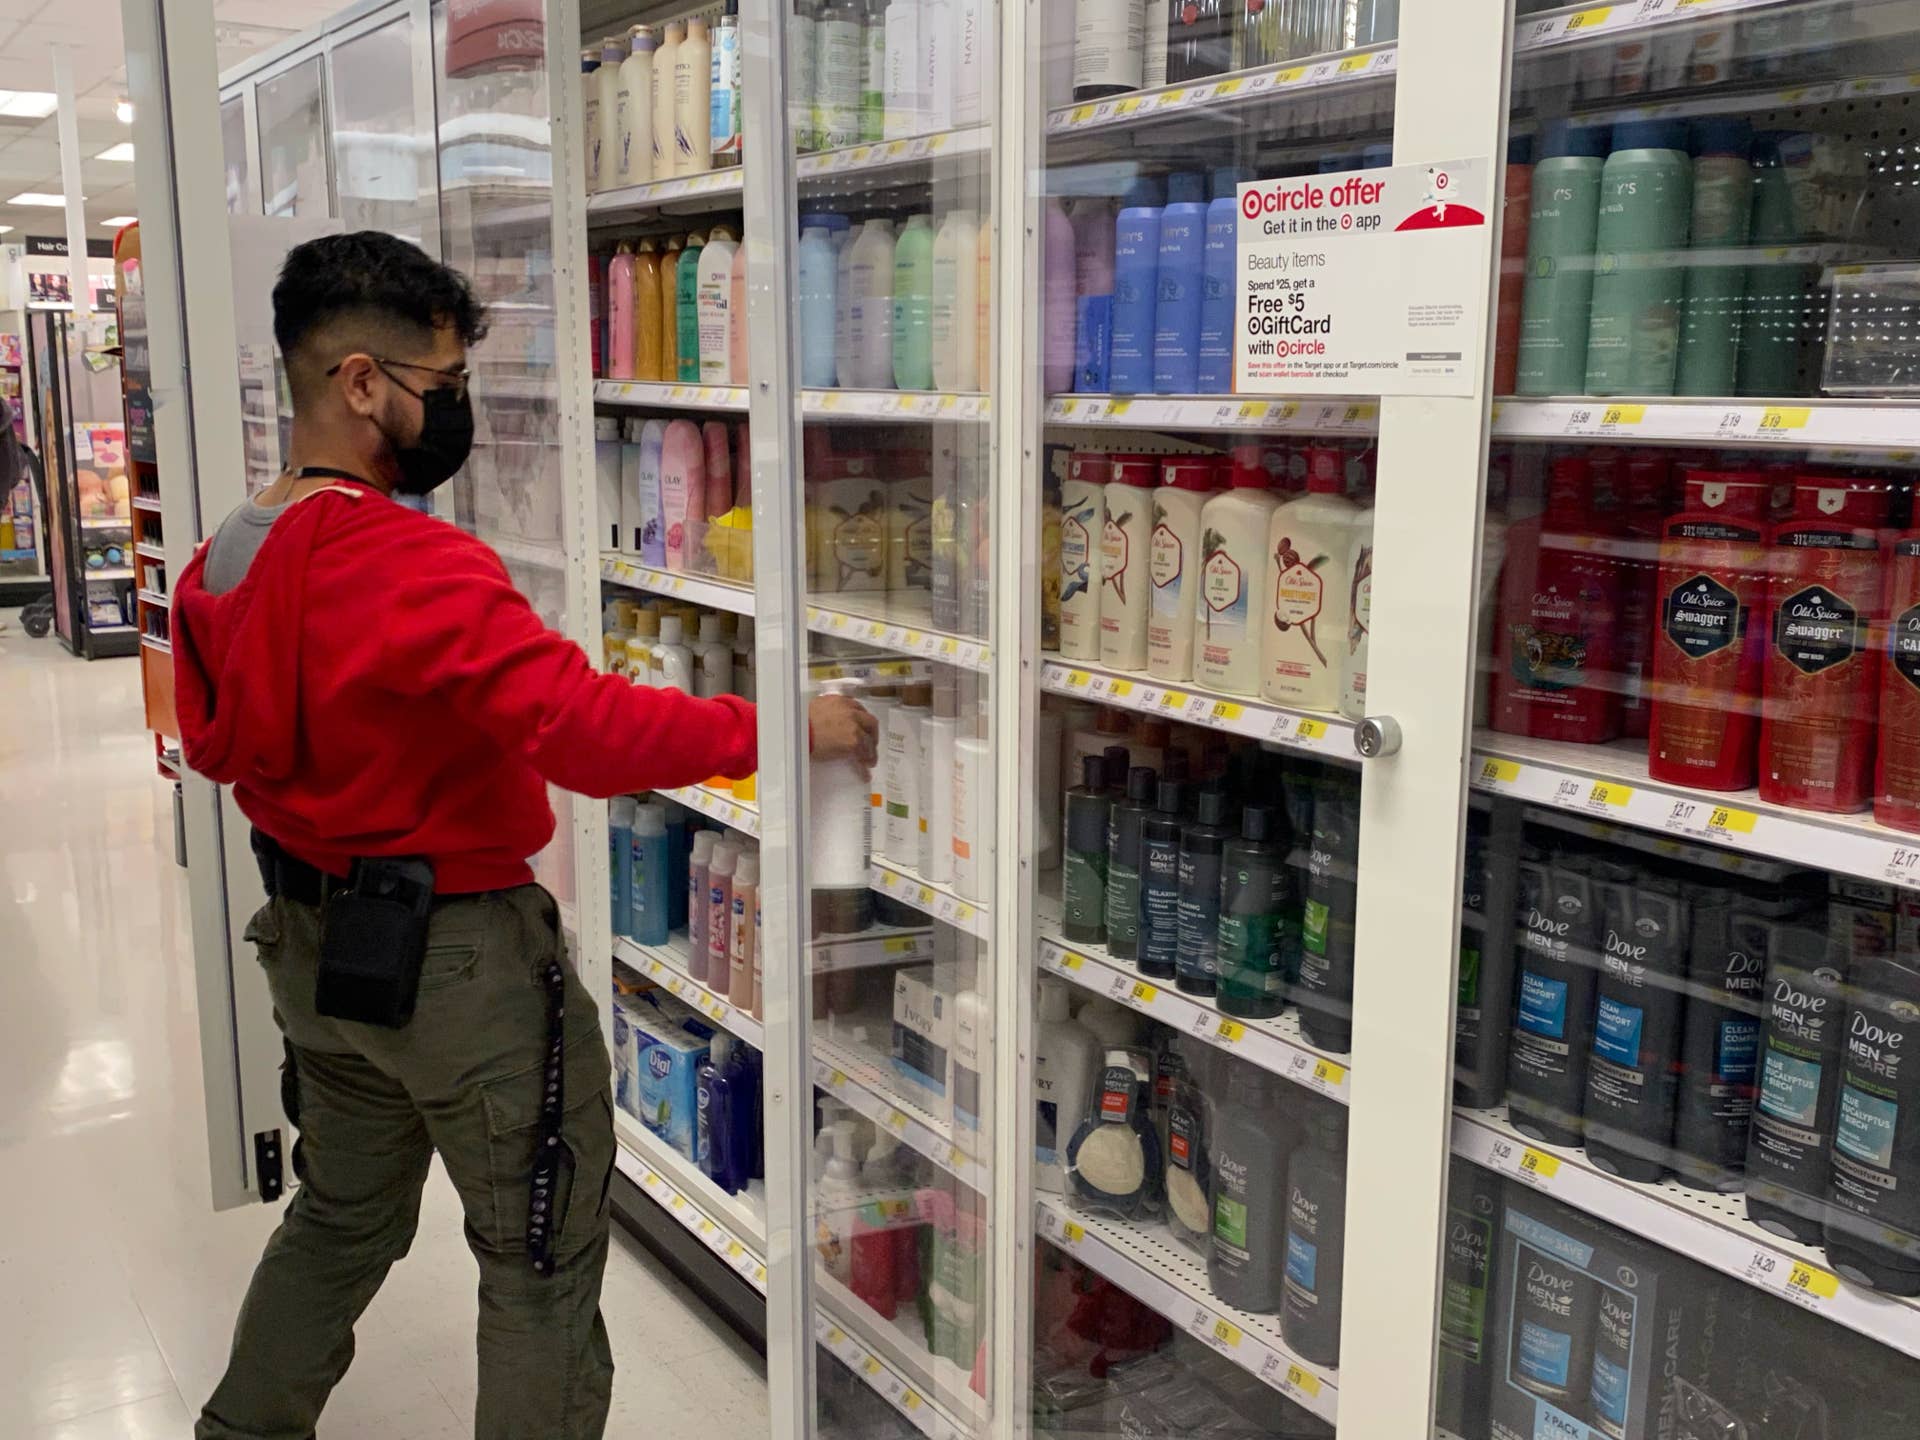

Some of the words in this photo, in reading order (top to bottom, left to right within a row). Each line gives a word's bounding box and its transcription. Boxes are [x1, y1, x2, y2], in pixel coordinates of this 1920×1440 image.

[964, 7, 975, 65] NATIVE
[1263, 183, 1323, 213] circle
[1330, 177, 1385, 207] offer
[1263, 220, 1285, 235] Get
[1289, 217, 1297, 234] it
[1301, 217, 1313, 232] in
[1316, 215, 1337, 231] the
[1356, 214, 1381, 230] app
[37, 242, 54, 250] Hair
[1248, 253, 1289, 272] Beauty
[1292, 251, 1326, 268] items
[1248, 280, 1275, 292] Spend
[1293, 279, 1307, 291] get
[1309, 280, 1315, 288] a
[1248, 295, 1283, 313] Free
[1288, 293, 1305, 313] $5
[1261, 315, 1331, 335] GiftCard
[1248, 340, 1274, 355] with
[1289, 339, 1325, 355] circle
[1294, 361, 1303, 369] the
[664, 475, 681, 486] OLAY
[1680, 591, 1699, 605] Old
[1698, 593, 1726, 608] Spice
[1674, 609, 1727, 627] Swagger
[1791, 604, 1811, 618] Old
[1811, 605, 1843, 620] Spice
[1785, 622, 1844, 641] Swagger
[1671, 803, 1696, 819] 12.17
[1708, 810, 1728, 826] 7.99
[1150, 848, 1176, 862] Dove
[1892, 850, 1920, 868] 12.17
[1527, 907, 1570, 937] Dove
[1526, 930, 1552, 949] MEN
[1605, 929, 1647, 961] Dove
[1604, 953, 1629, 973] MEN
[1523, 975, 1544, 989] CLEAN
[1725, 977, 1762, 990] MEN
[1773, 978, 1827, 1013] Dove
[1600, 1001, 1620, 1015] CLEAN
[1771, 1004, 1804, 1026] MEN
[904, 1003, 934, 1033] IVORY
[1599, 1010, 1632, 1028] COMFORT
[1725, 1026, 1754, 1035] CLEAN
[1850, 1010, 1904, 1049] Dove
[1848, 1037, 1880, 1062] MEN
[649, 1050, 671, 1075] Dial
[1766, 1056, 1785, 1070] BLUE
[1105, 1068, 1132, 1081] Dove
[1765, 1066, 1815, 1089] EUCALYPTUS
[1768, 1077, 1793, 1093] BIRCH
[1842, 1093, 1860, 1108] BLUE
[1841, 1103, 1891, 1129] EUCALYPTUS
[1845, 1115, 1869, 1131] BIRCH
[1219, 1151, 1248, 1176] Dove
[1292, 1186, 1319, 1215] Dove
[1554, 1240, 1584, 1257] SAVE
[1751, 1251, 1776, 1273] 14.20
[1527, 1261, 1574, 1293] Dove
[1789, 1269, 1811, 1288] 7.99
[1526, 1282, 1556, 1303] MEN
[1601, 1292, 1632, 1324] Dove
[1543, 1410, 1550, 1423] 2
[1552, 1415, 1579, 1439] PACK
